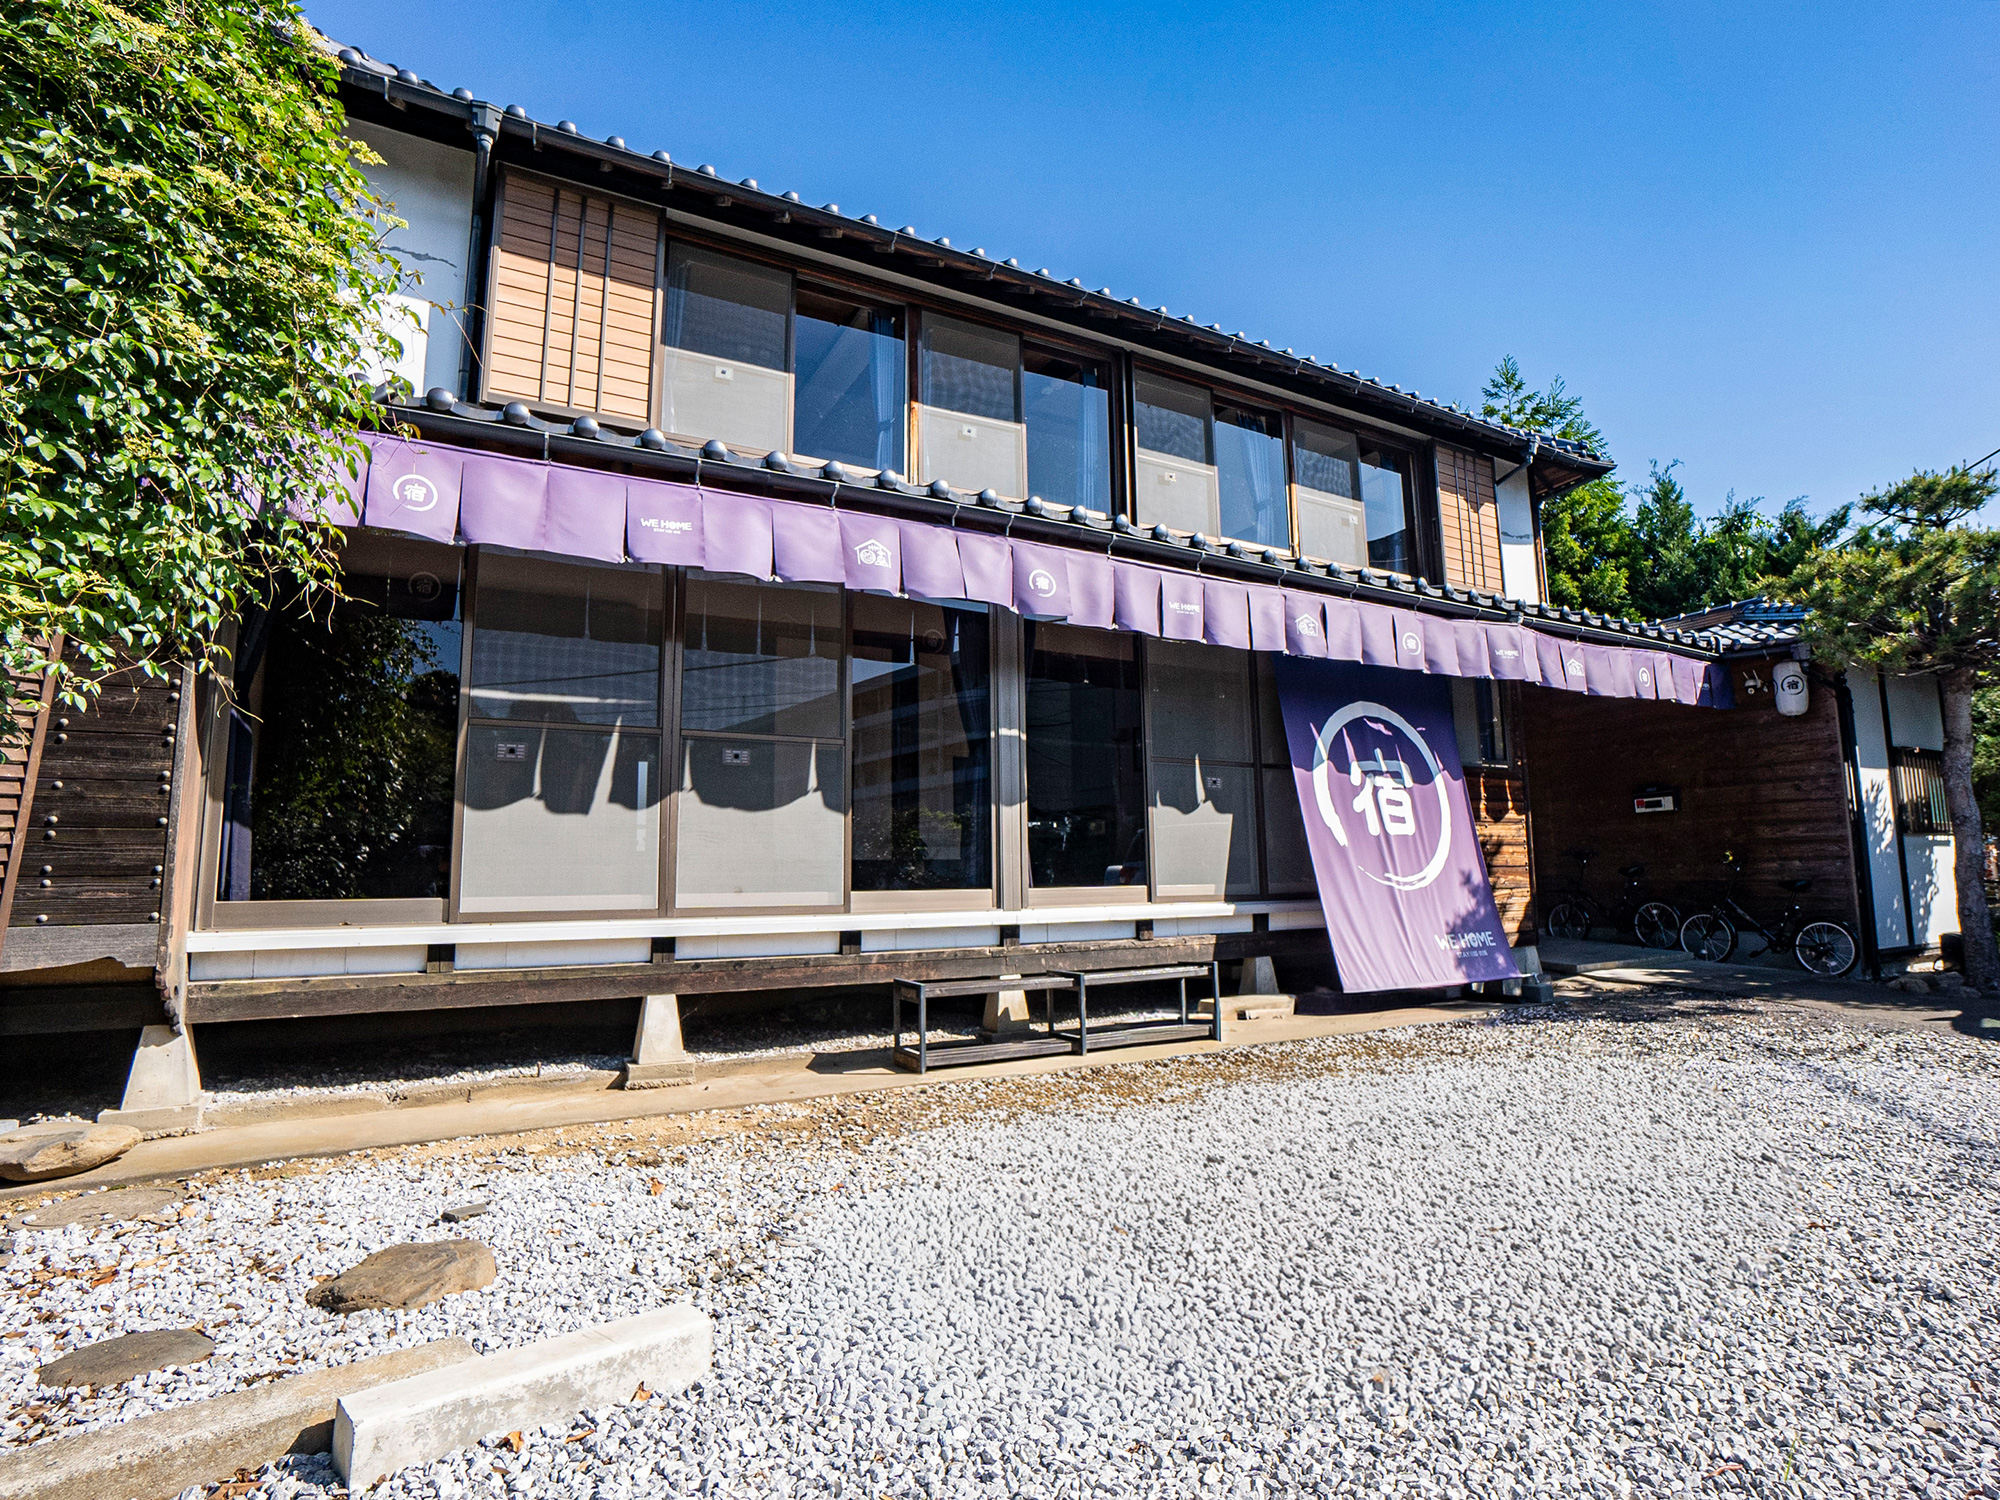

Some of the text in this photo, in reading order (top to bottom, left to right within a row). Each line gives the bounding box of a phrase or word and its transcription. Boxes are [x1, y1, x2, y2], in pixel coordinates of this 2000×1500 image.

[404, 483, 427, 502] 宿
[641, 518, 659, 527] WE
[660, 520, 693, 531] HOME
[1036, 576, 1050, 590] 宿
[1169, 601, 1180, 610] WE
[1181, 603, 1200, 613] HOME
[1787, 680, 1799, 690] 宿
[1350, 748, 1416, 836] 宿
[1434, 931, 1497, 950] WE HOME
